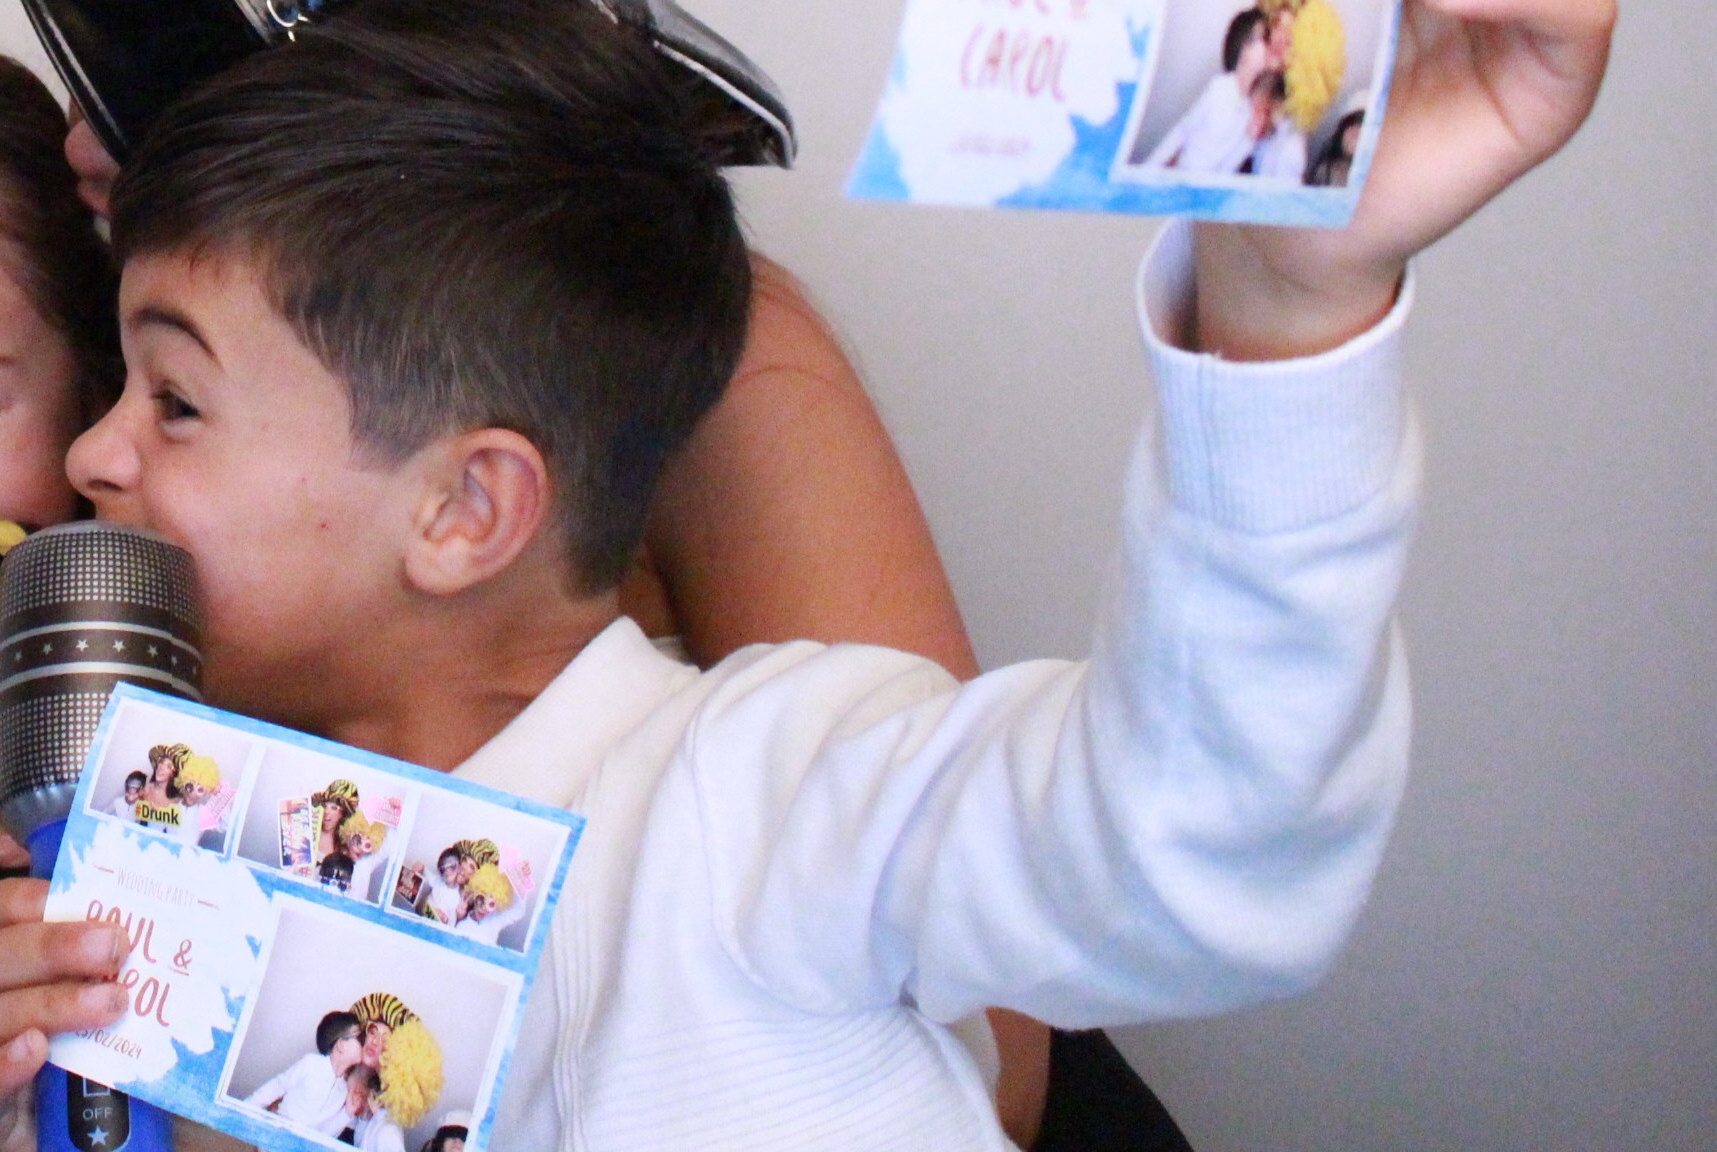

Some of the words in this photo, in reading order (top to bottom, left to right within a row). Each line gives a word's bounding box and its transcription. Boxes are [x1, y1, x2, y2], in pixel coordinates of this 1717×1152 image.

[959, 23, 1070, 103] CAROL
[135, 804, 180, 825] #Drunk
[116, 867, 163, 900] WEDDING
[172, 938, 193, 970] &
[82, 1107, 113, 1121] OFF
